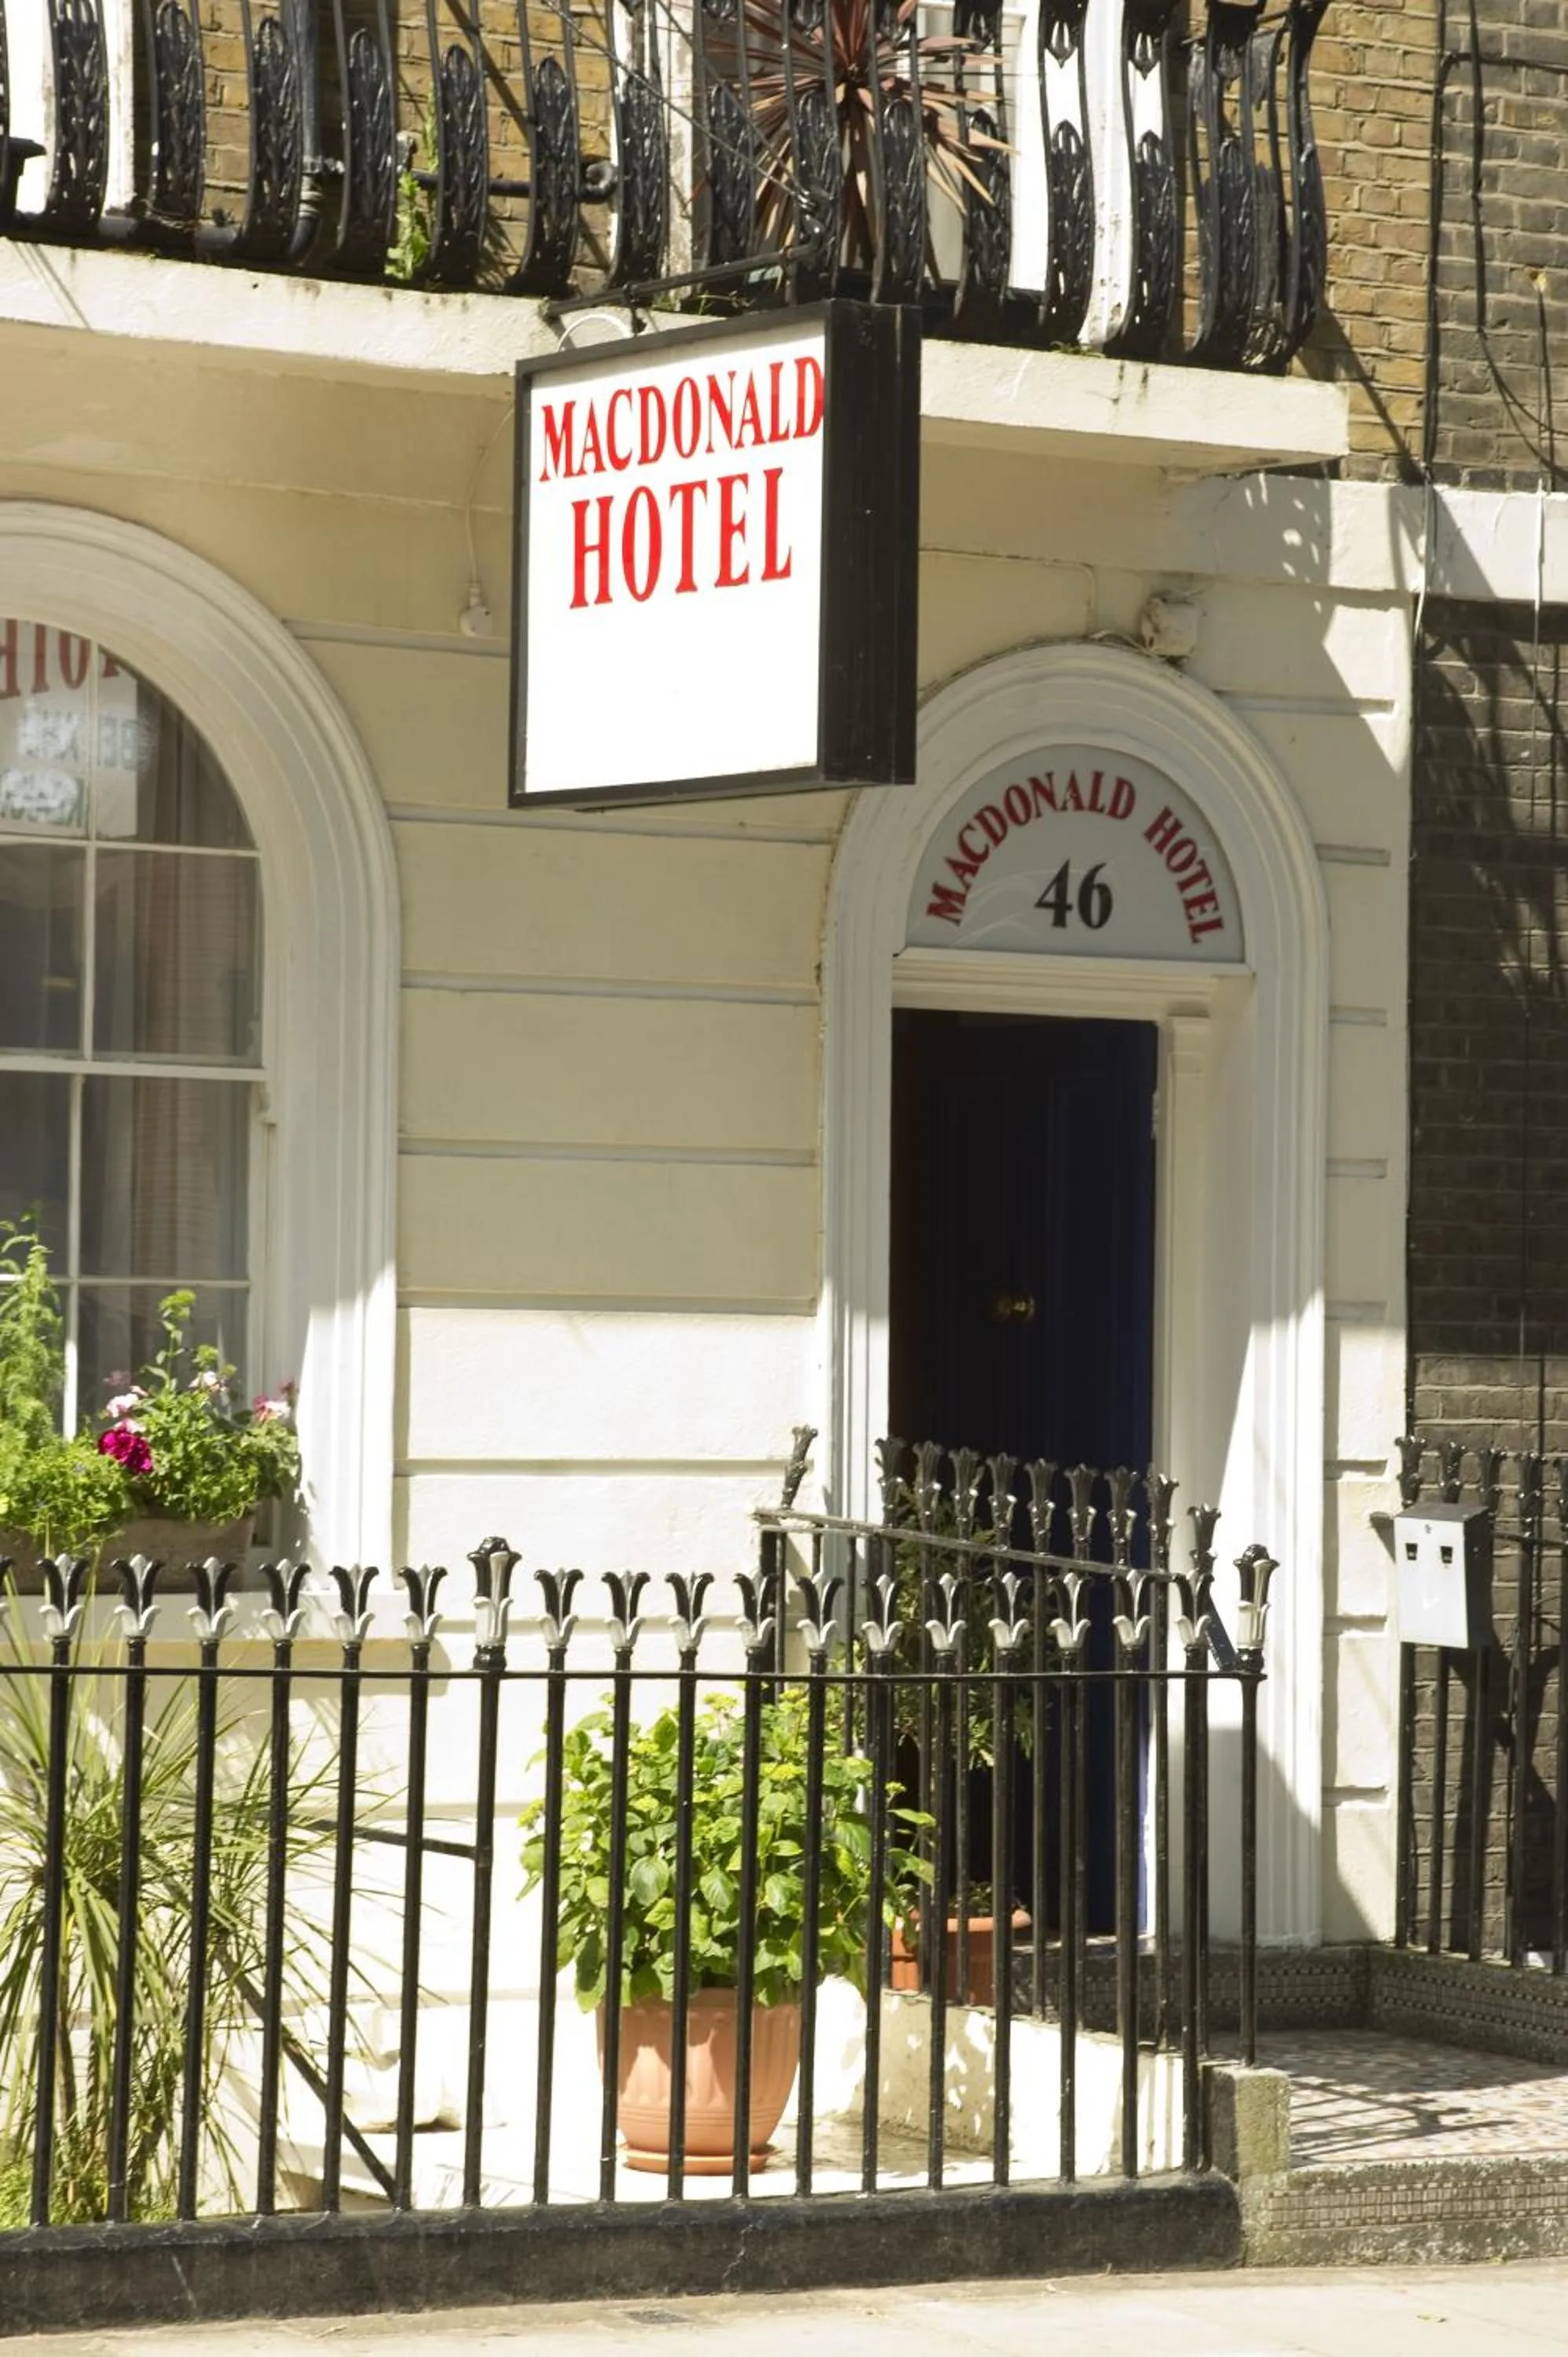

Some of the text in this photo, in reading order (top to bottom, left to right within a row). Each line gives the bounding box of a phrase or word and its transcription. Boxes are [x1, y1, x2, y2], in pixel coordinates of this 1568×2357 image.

[539, 356, 824, 482] MACDONALD
[570, 467, 792, 610] HOTEL
[925, 769, 1225, 944] MACDONALD HOTEL
[1034, 858, 1114, 930] 46
